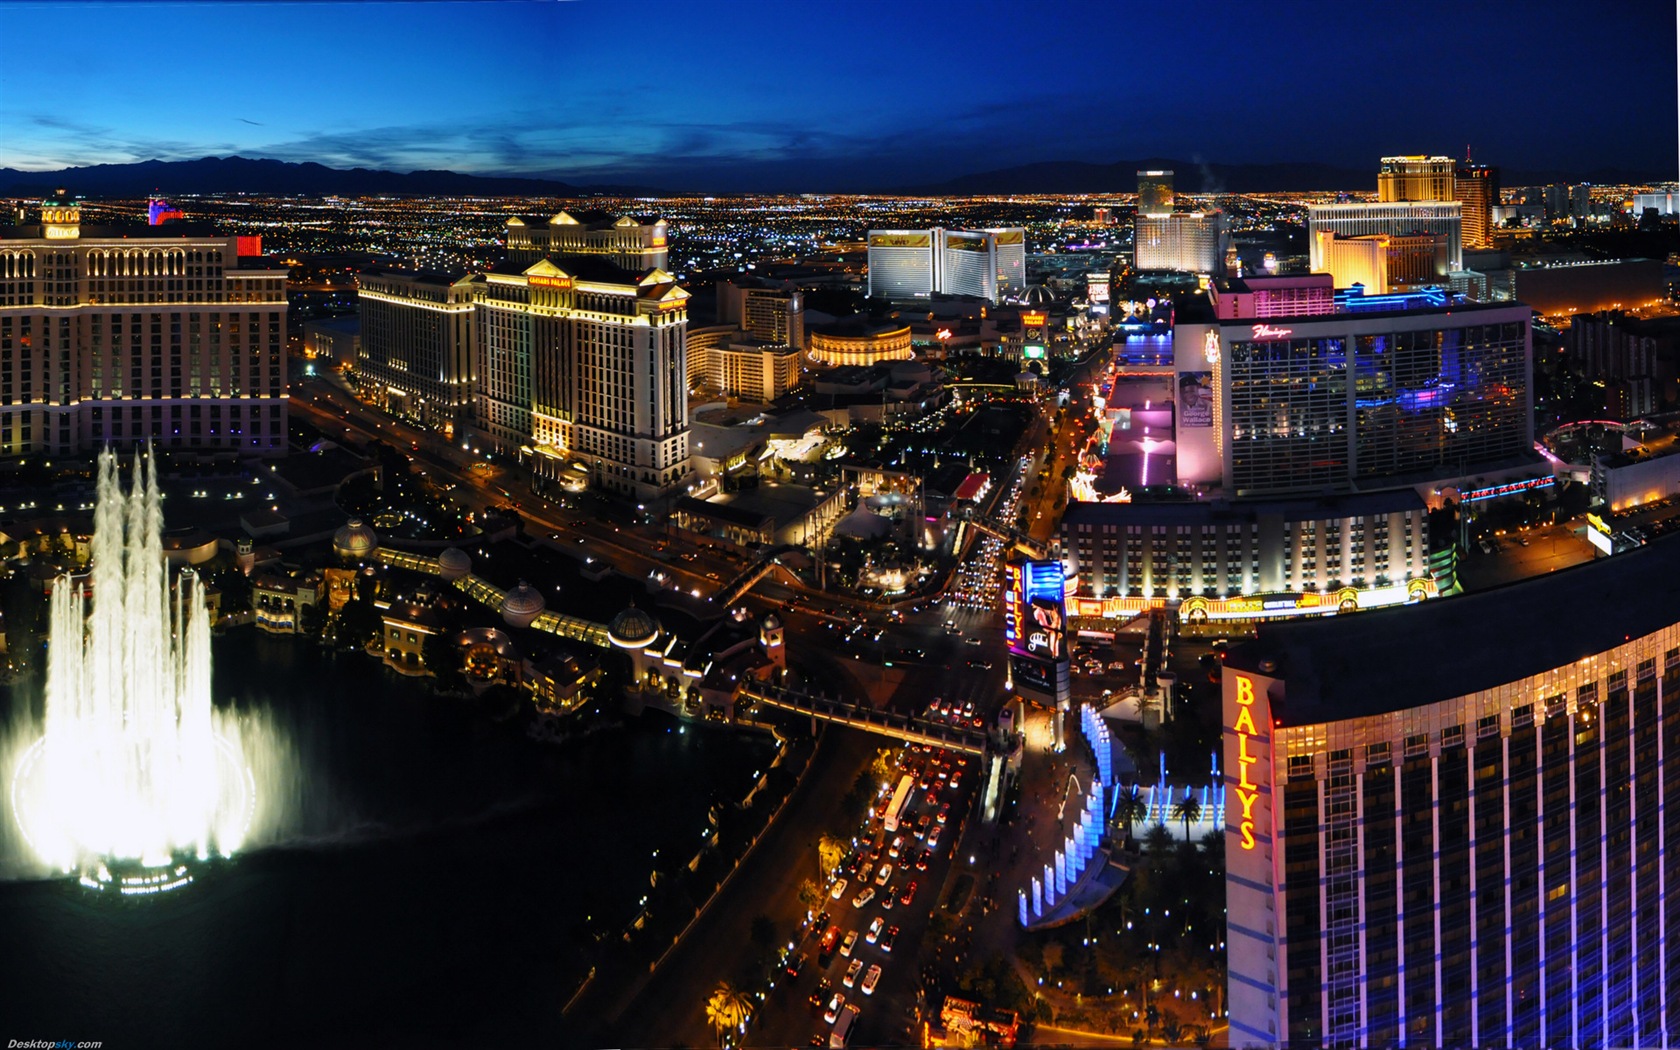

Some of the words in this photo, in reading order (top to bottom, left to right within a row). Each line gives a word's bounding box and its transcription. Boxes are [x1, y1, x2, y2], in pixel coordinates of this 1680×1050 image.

[529, 276, 550, 285] CAESARS
[551, 278, 571, 288] PALACE
[1252, 324, 1292, 339] Flamingo
